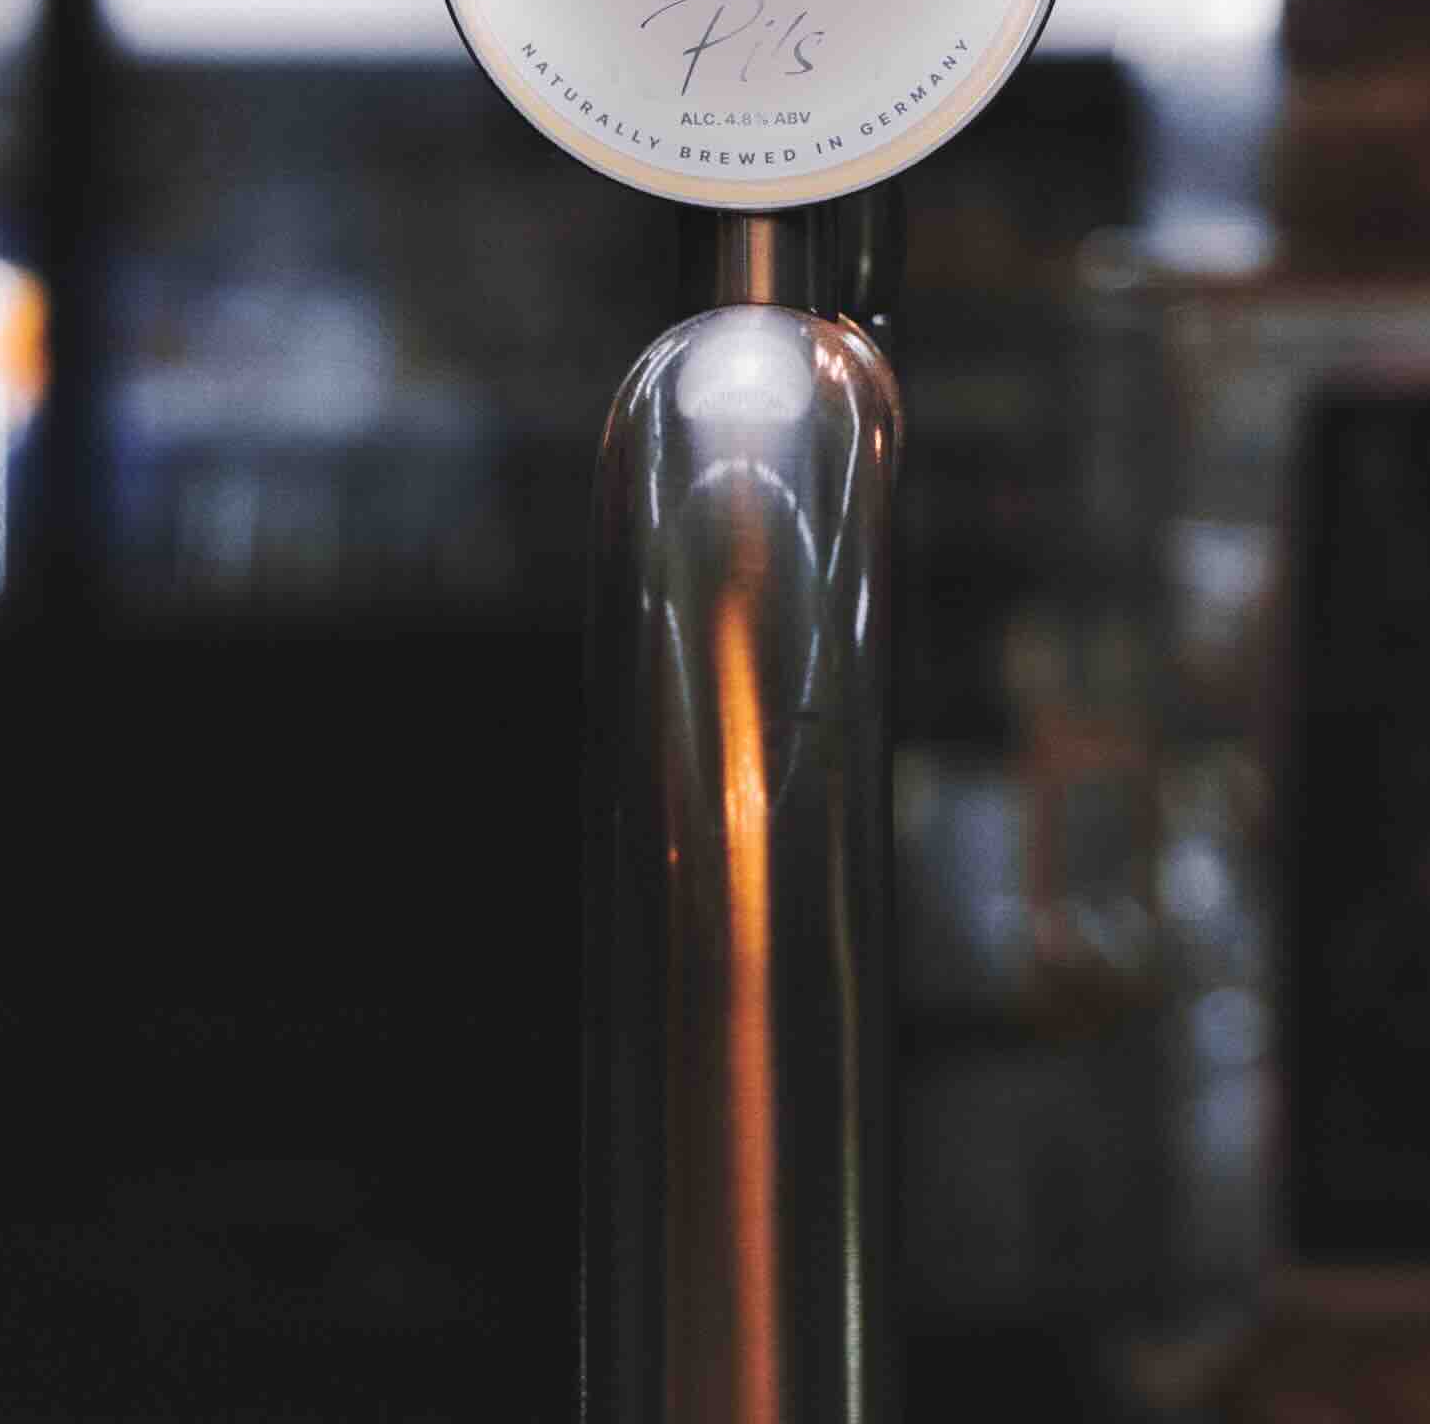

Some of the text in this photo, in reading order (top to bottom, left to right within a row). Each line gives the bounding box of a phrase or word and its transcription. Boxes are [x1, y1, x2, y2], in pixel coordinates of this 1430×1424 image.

[522, 39, 968, 166] NATURALLY BREWED IN GERMANY
[680, 111, 722, 126] ALC.
[774, 111, 811, 126] ABV
